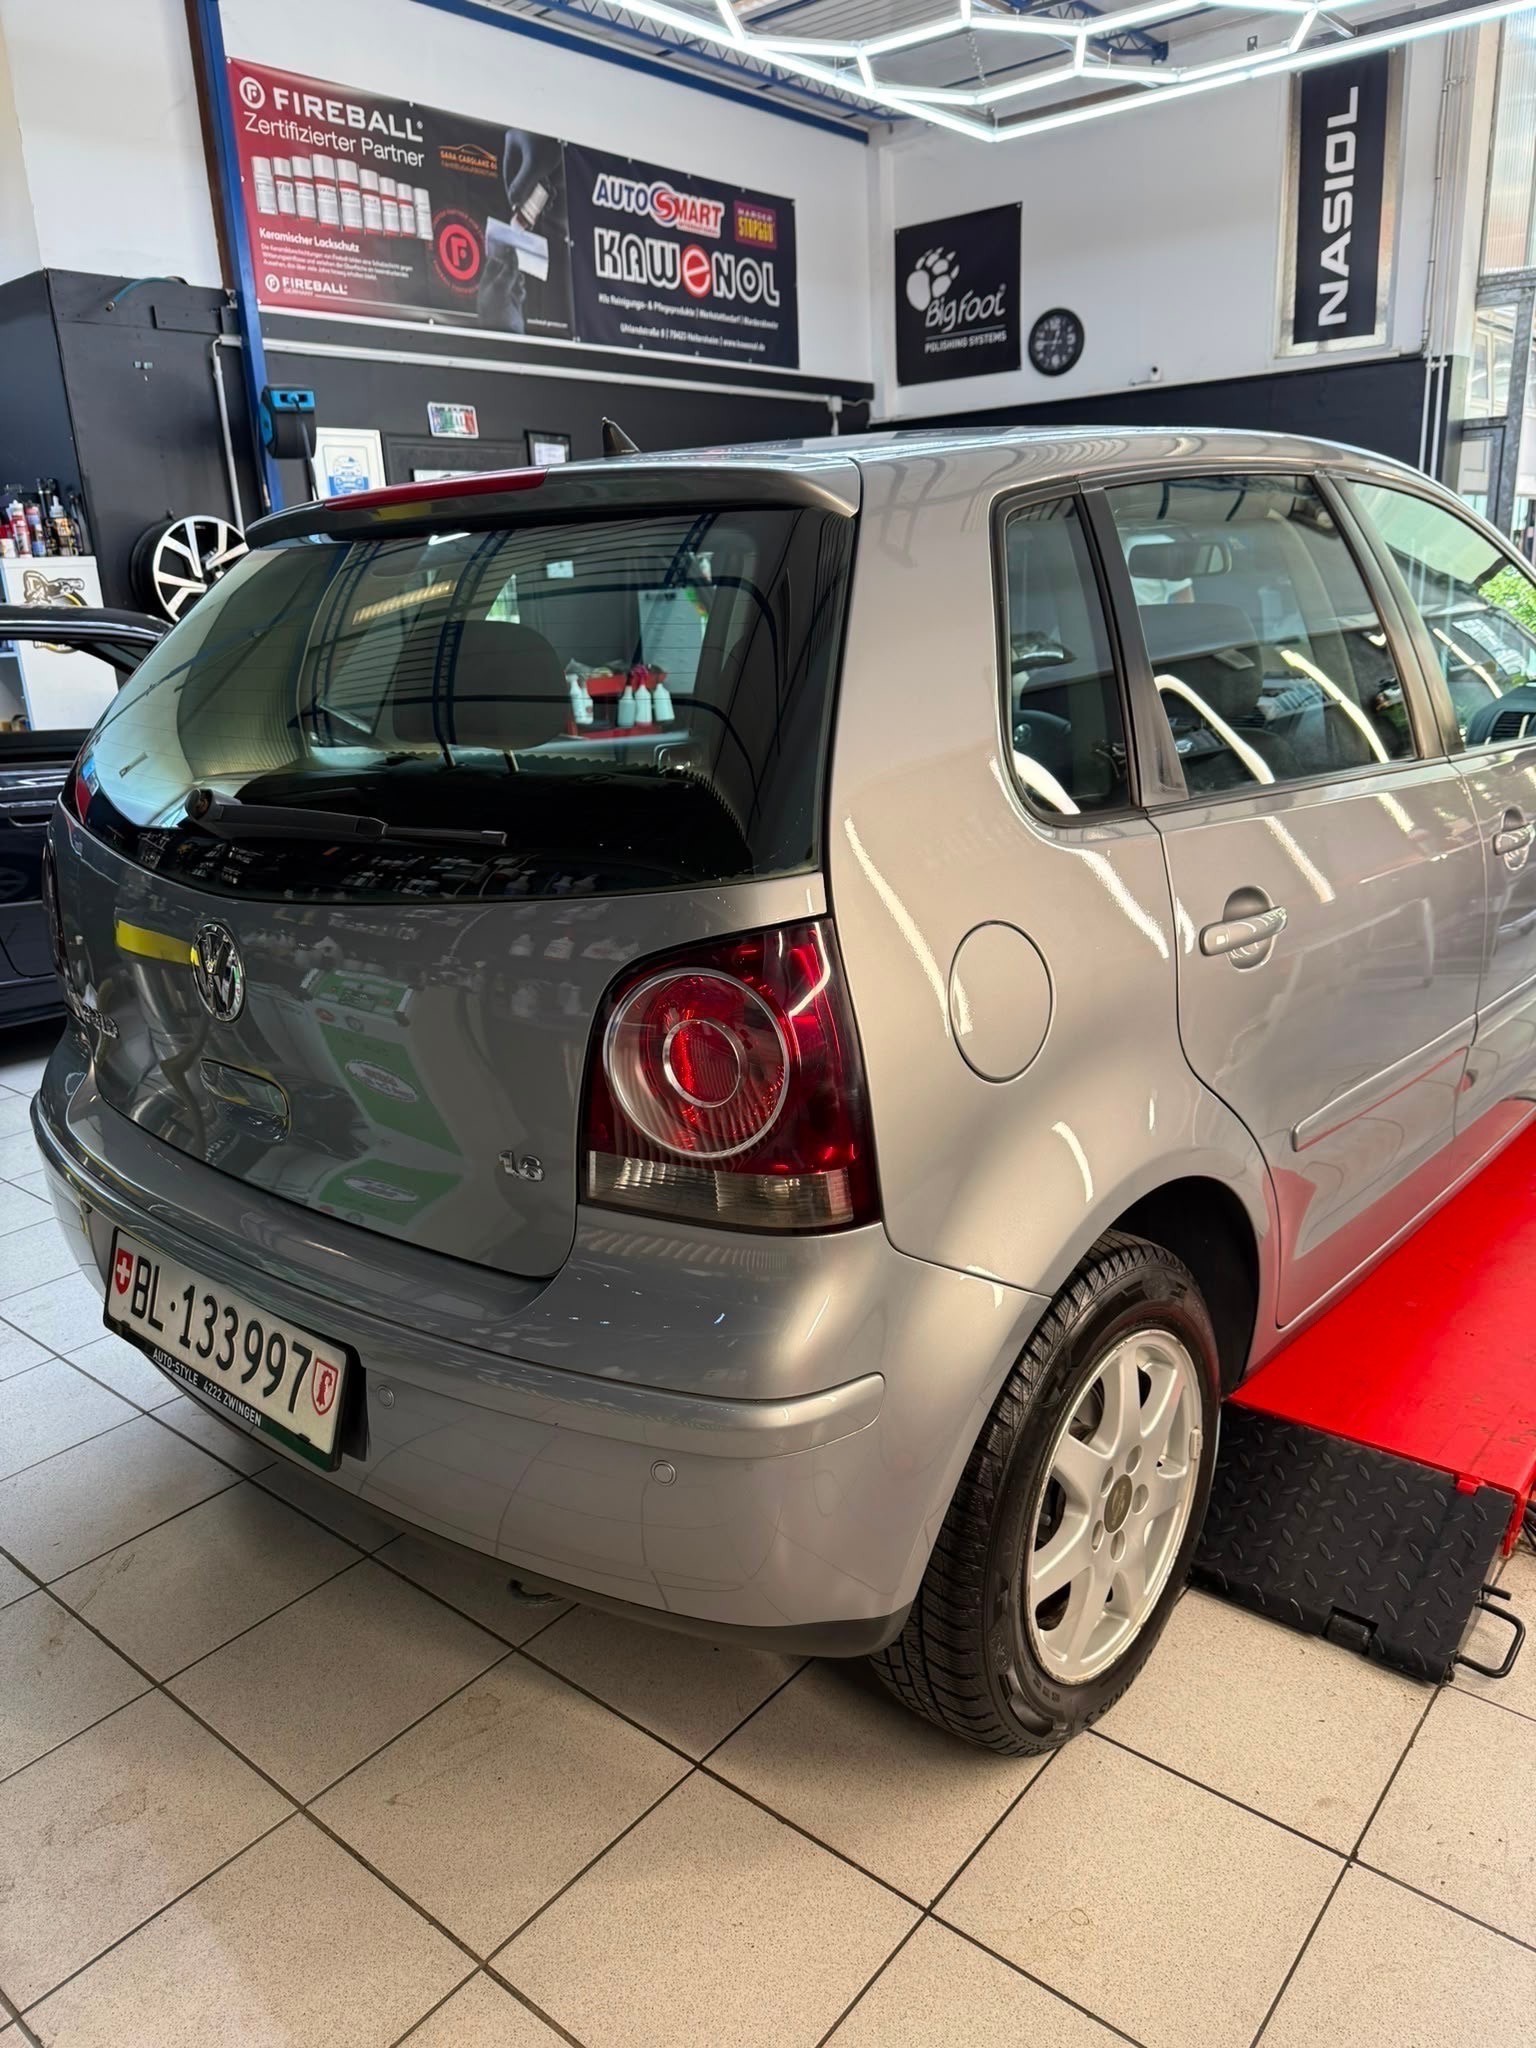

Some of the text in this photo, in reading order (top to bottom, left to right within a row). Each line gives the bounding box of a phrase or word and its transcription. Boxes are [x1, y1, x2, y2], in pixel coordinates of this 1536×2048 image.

[243, 111, 425, 168] Zertifizierter Partner
[1318, 86, 1358, 327] NASIOL
[259, 228, 360, 252] Keramischer Lackschutz
[924, 330, 1007, 354] POLISHING SYSTEMS
[152, 1347, 262, 1428] AUTO-STYLE 4222 ZWINGEN
